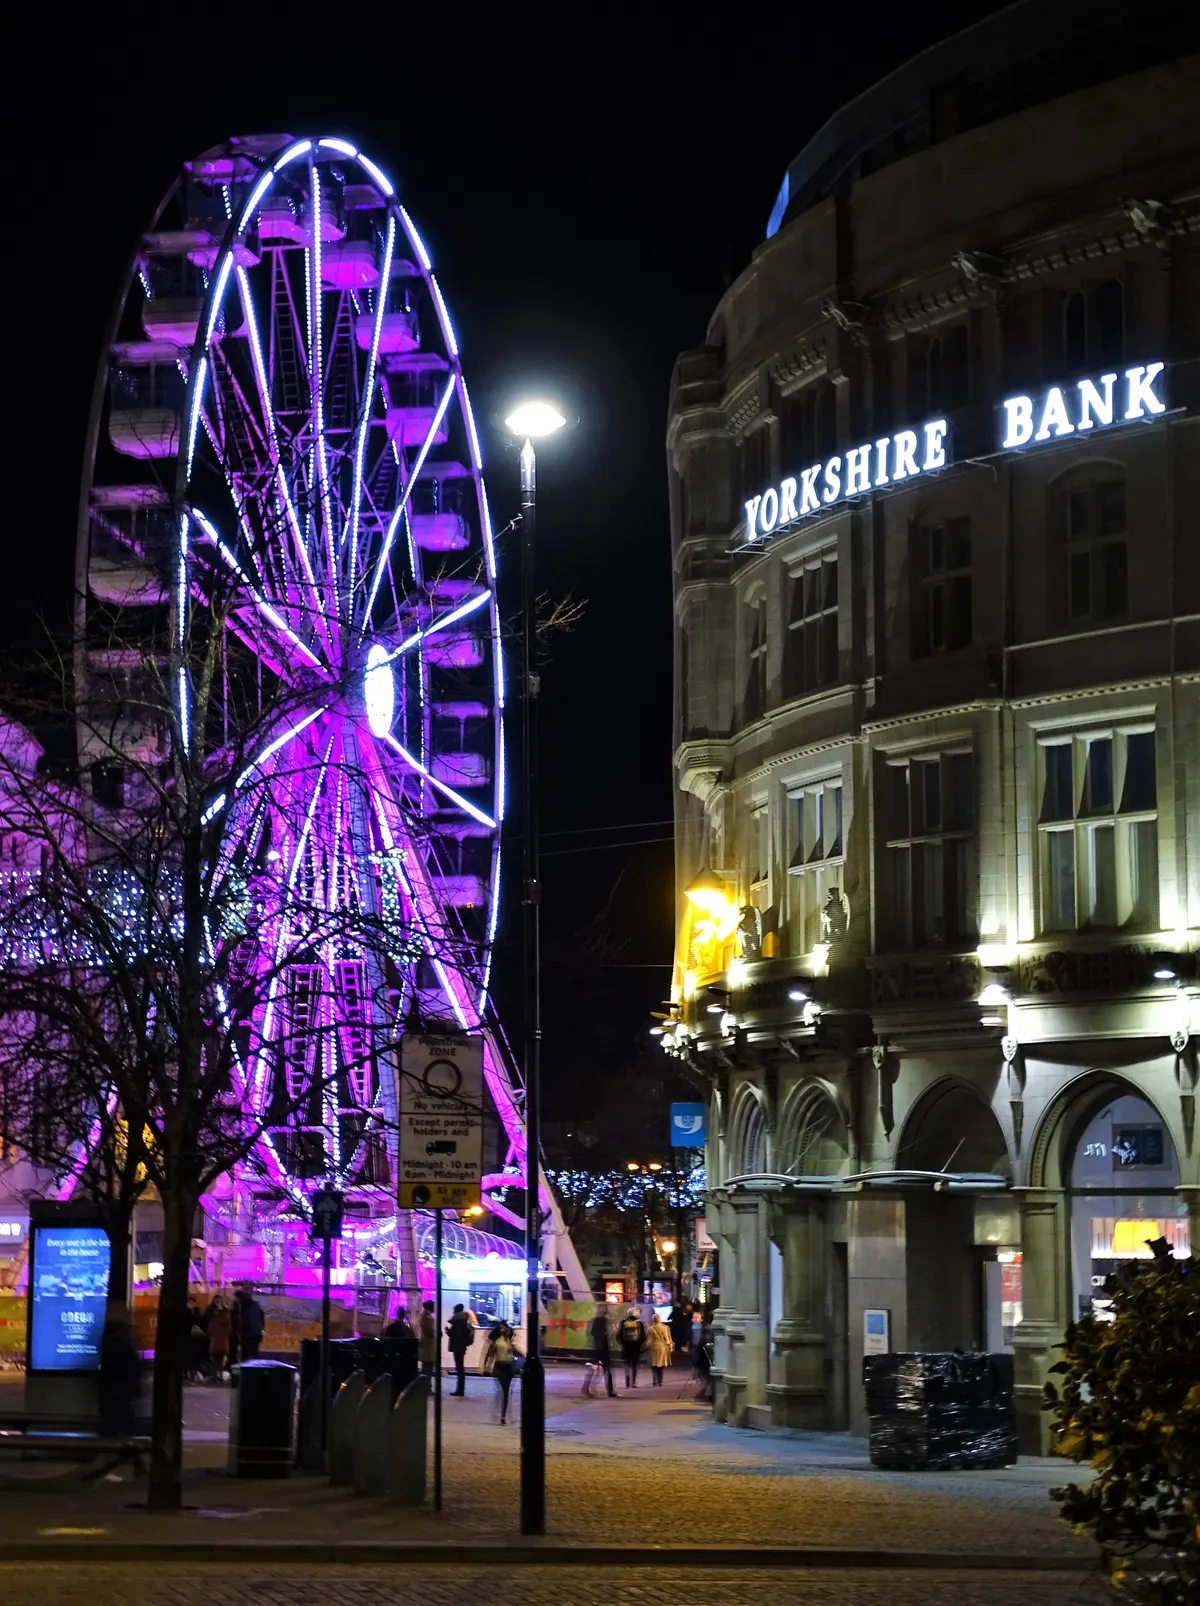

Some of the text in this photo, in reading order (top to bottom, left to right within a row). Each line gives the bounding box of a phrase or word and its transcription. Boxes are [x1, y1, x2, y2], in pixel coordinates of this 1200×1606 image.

[744, 361, 1166, 542] YORKSHIRE BANK
[428, 1047, 457, 1056] ZONE
[414, 1101, 427, 1110] No
[408, 1117, 440, 1127] Except
[413, 1127, 469, 1136] holders and
[402, 1160, 444, 1170] Midnight
[451, 1160, 462, 1169] 10
[404, 1170, 427, 1179] 6pm
[433, 1170, 475, 1180] Midnight
[60, 1311, 95, 1323] ODEON
